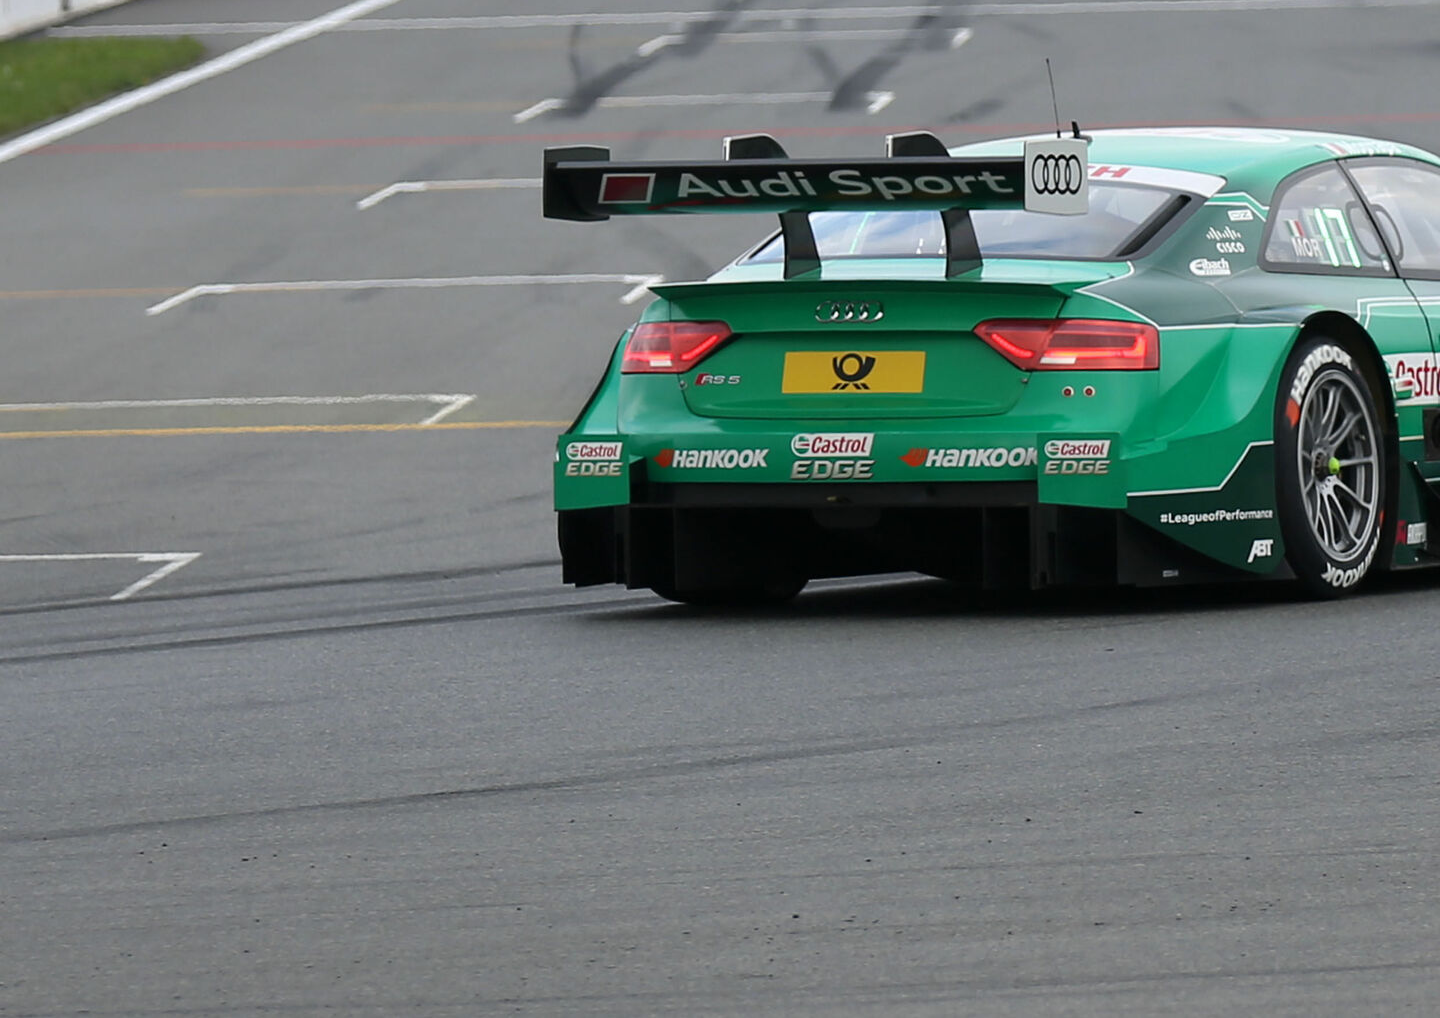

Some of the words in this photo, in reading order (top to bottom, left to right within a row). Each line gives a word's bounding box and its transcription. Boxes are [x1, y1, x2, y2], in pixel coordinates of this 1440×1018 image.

[677, 170, 817, 199] Audi
[828, 168, 1013, 201] Sport
[1313, 207, 1362, 268] 17
[1291, 237, 1321, 258] MOR
[701, 375, 726, 384] RS
[579, 444, 619, 459] Castrol
[811, 435, 867, 455] Castrol
[1060, 442, 1107, 457] Castrol
[565, 461, 623, 477] EDGE
[789, 459, 875, 480] EDGE
[1043, 459, 1111, 475] EDGE
[1160, 508, 1274, 526] #LeagueofPerformance
[1247, 538, 1274, 564] ABT
